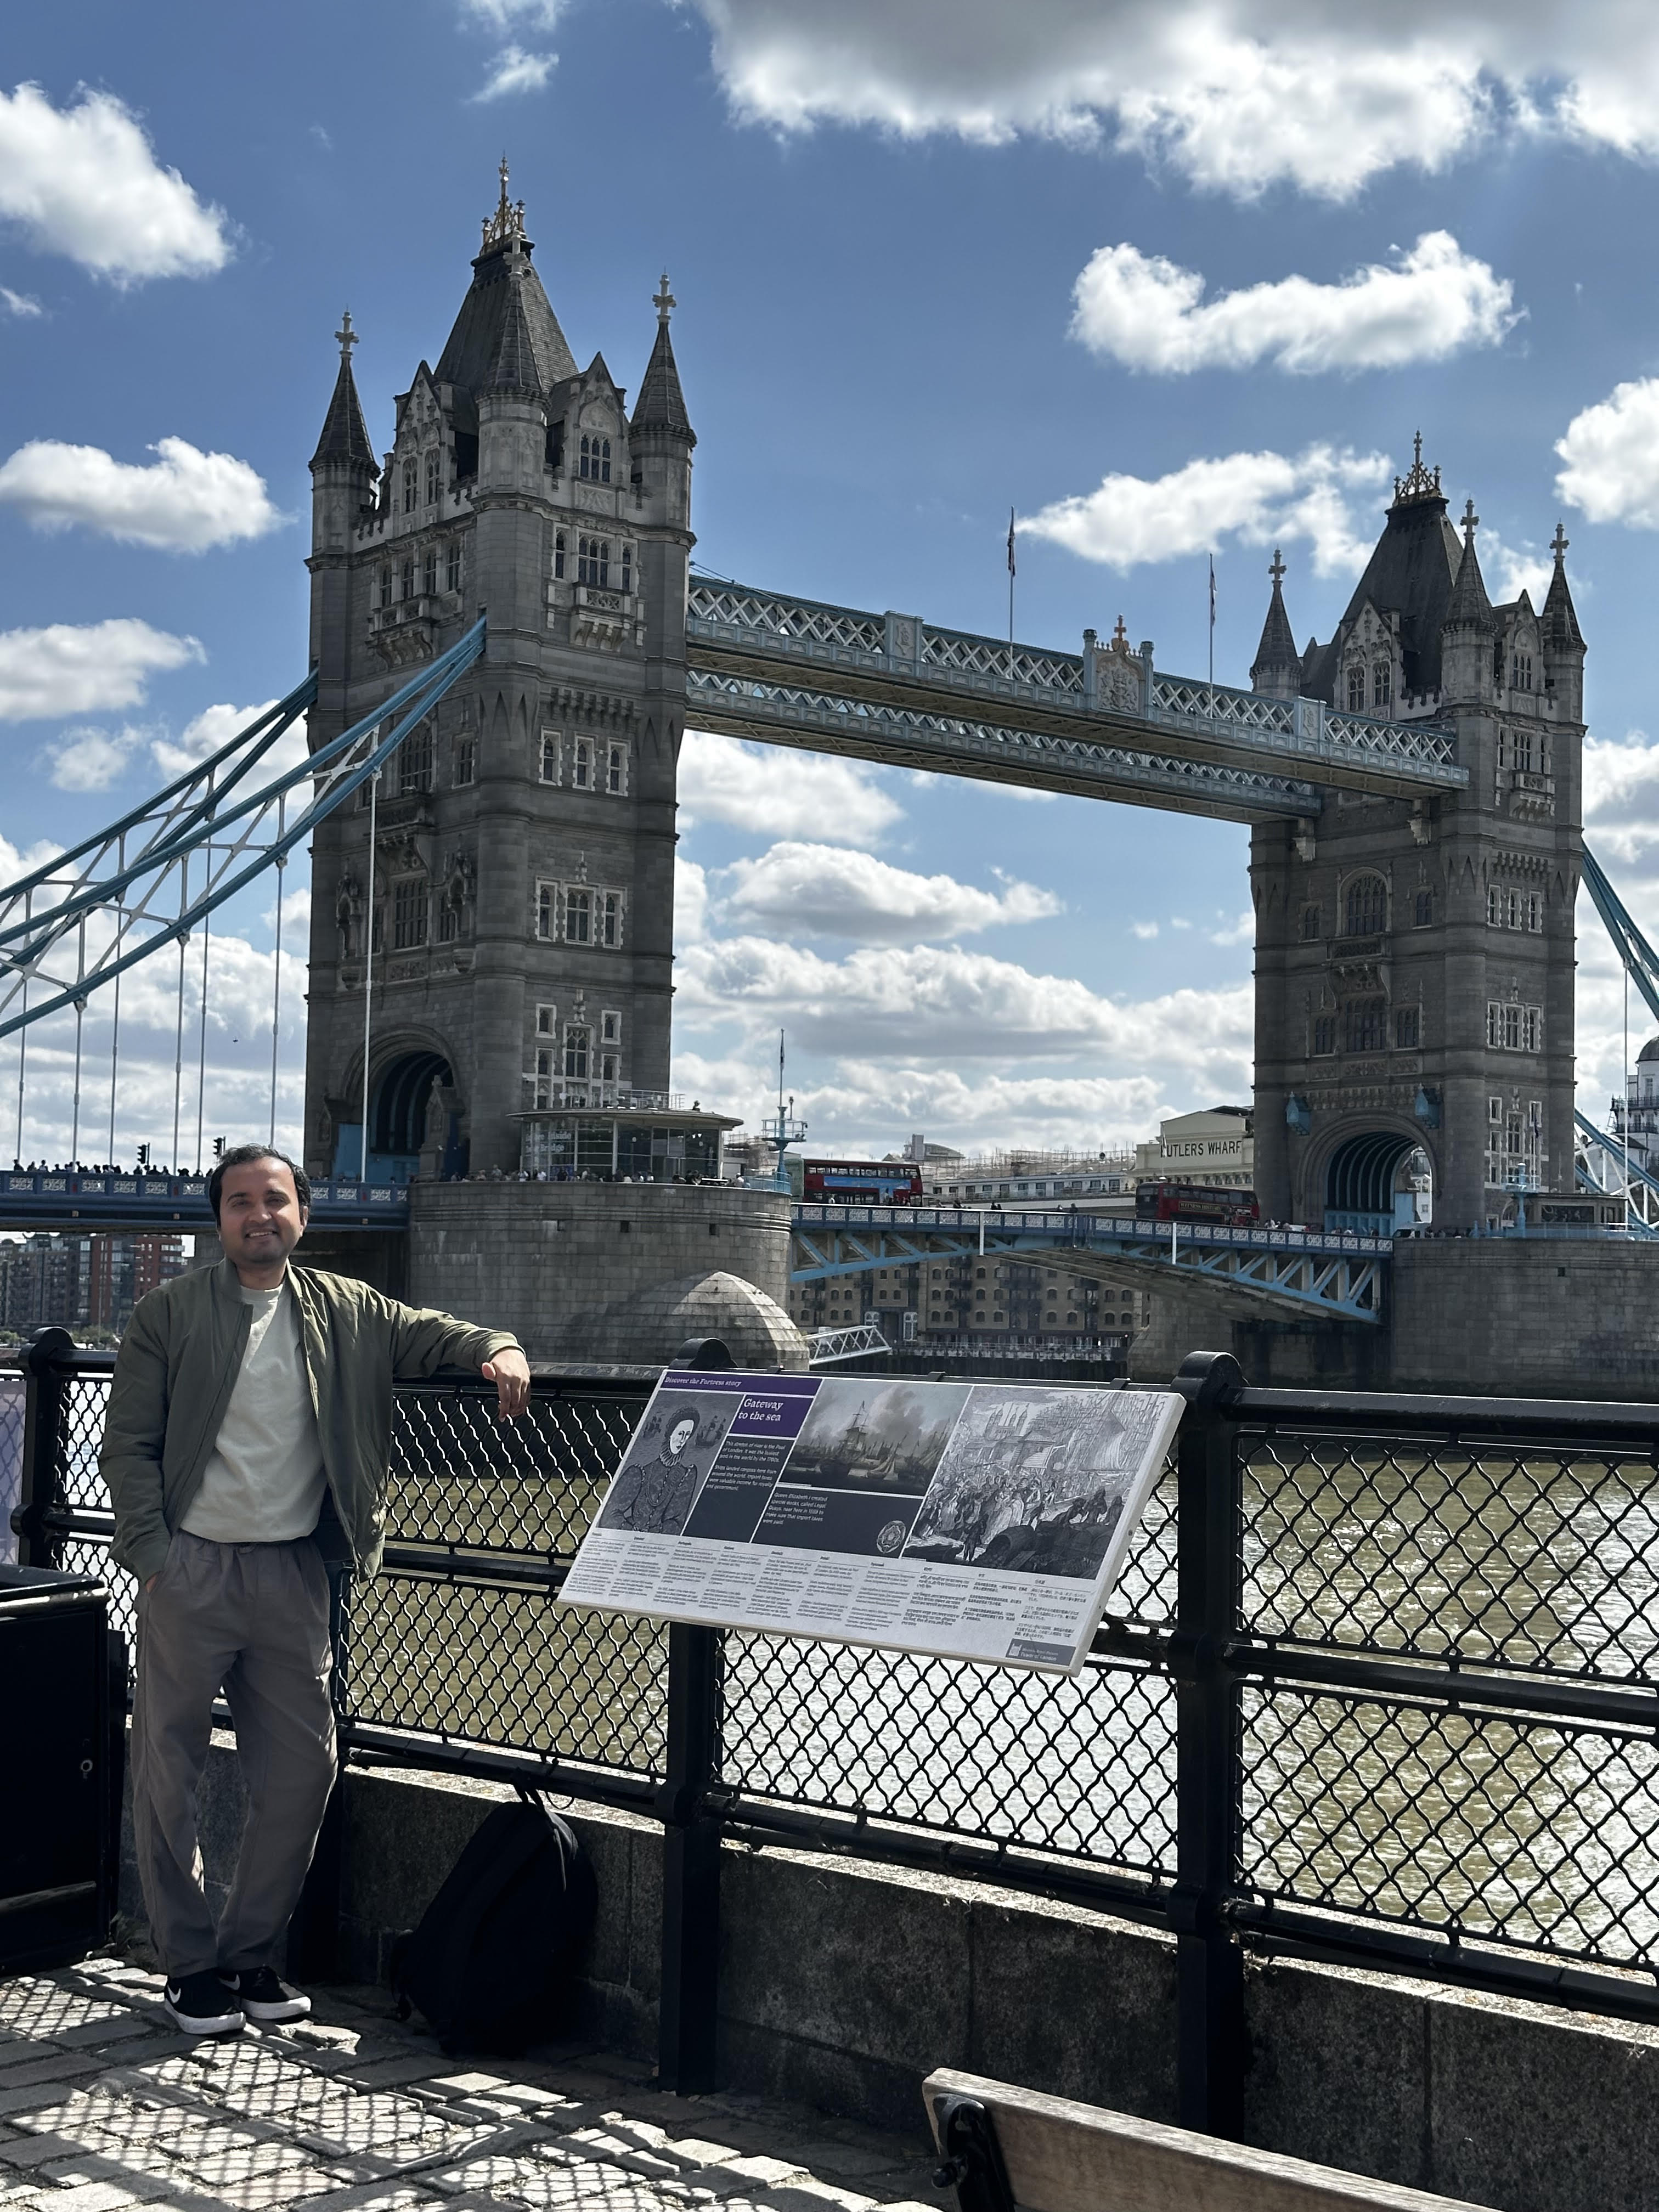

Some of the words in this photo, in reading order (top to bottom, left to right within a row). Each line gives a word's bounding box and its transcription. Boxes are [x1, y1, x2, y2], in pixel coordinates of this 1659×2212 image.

[1208, 1141, 1242, 1155] WHARF
[744, 1398, 784, 1411] Gateway
[738, 1411, 748, 1419] to
[749, 1411, 765, 1420] the
